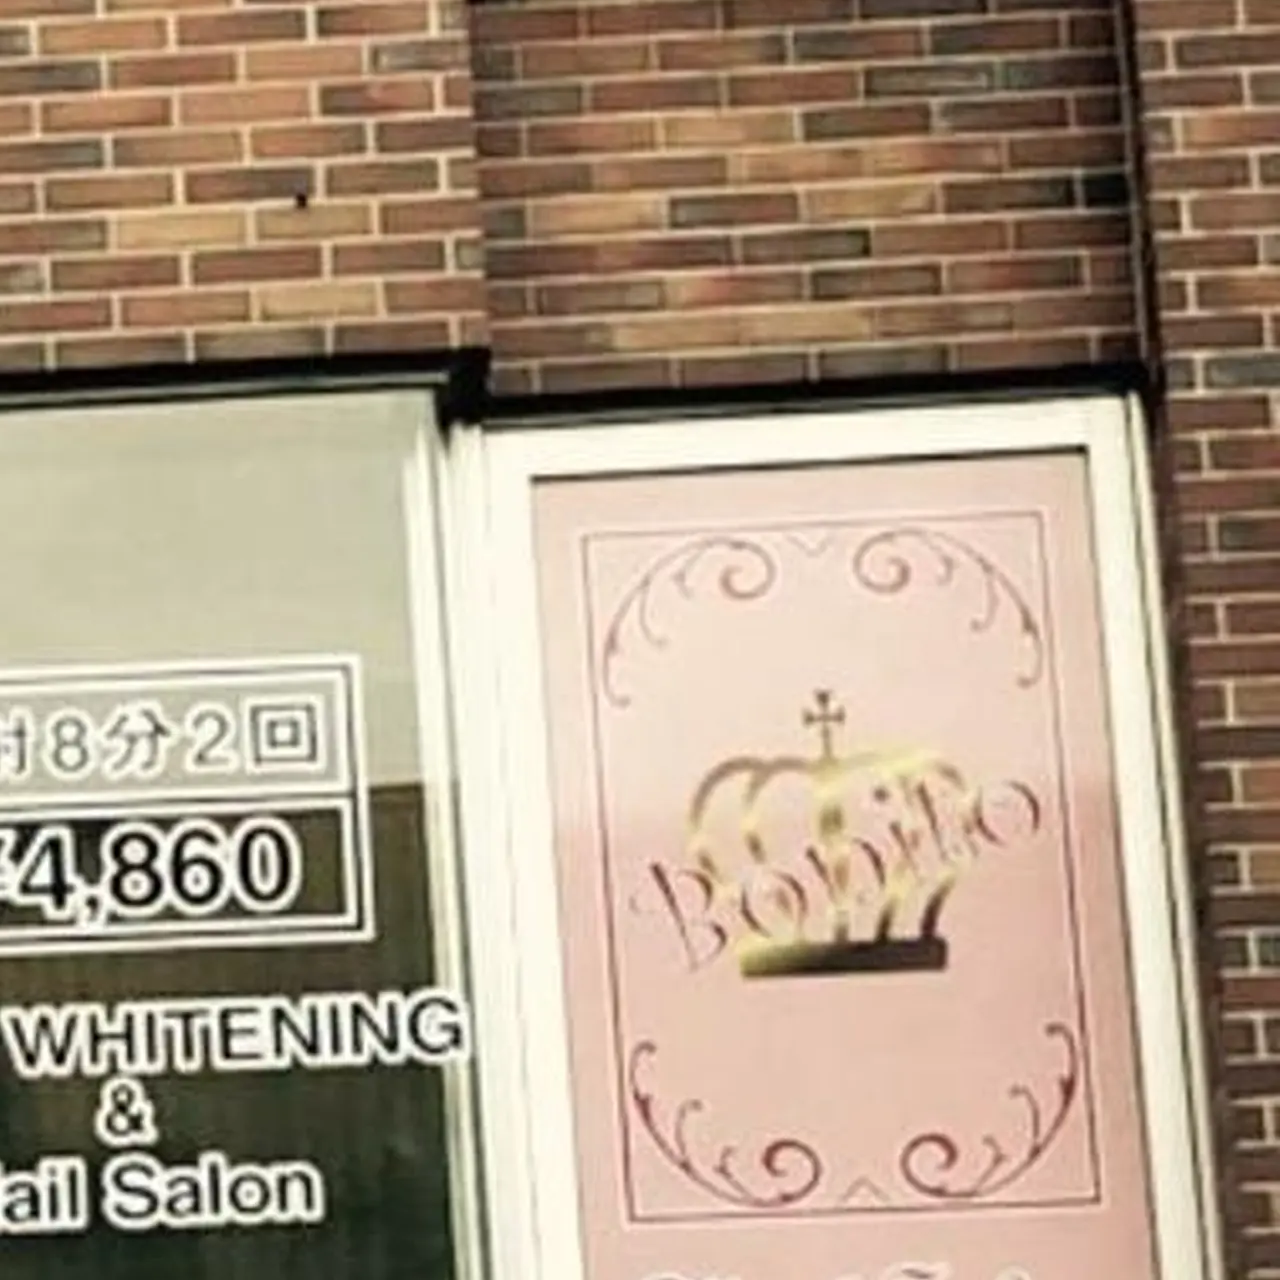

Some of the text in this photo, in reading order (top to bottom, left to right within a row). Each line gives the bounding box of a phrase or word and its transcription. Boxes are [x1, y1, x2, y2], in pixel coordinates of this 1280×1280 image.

[1, 989, 472, 1080] WHITENING
[96, 1078, 157, 1147] &
[102, 1150, 327, 1227] Salon
